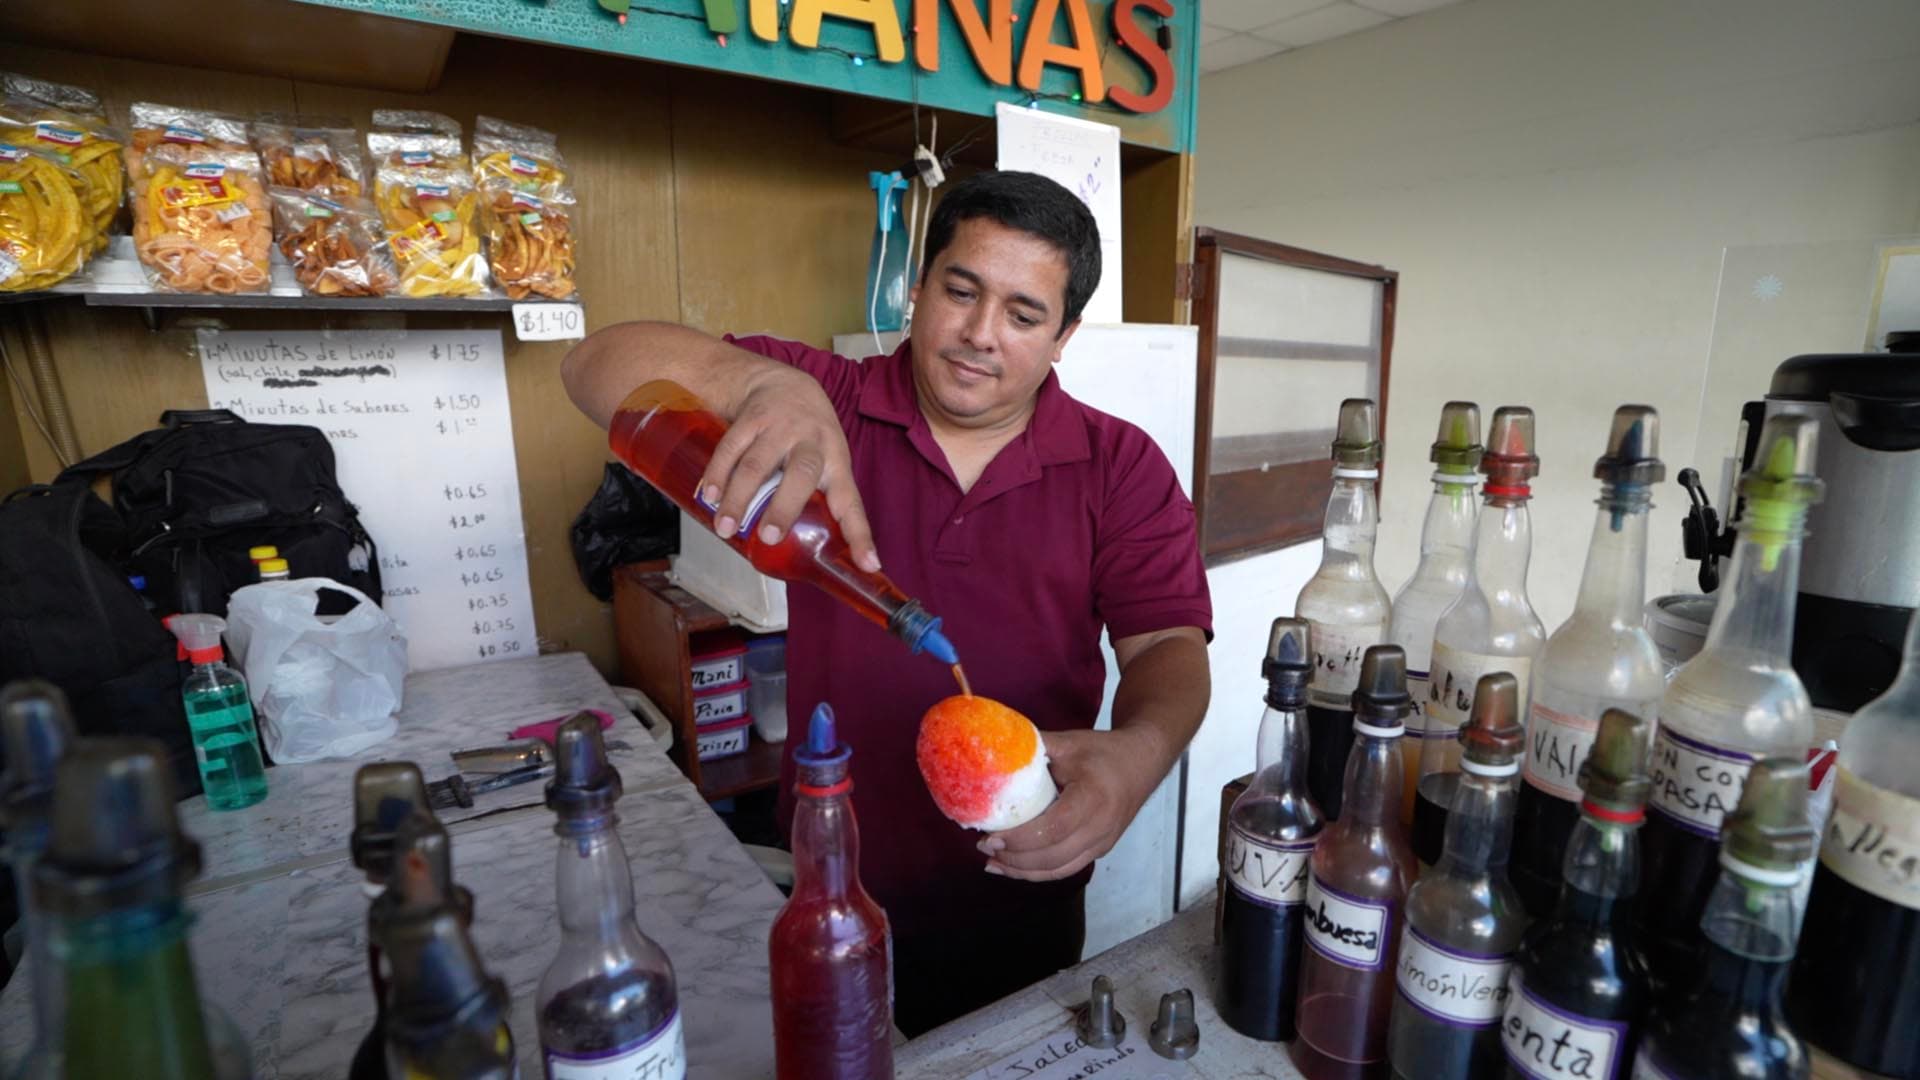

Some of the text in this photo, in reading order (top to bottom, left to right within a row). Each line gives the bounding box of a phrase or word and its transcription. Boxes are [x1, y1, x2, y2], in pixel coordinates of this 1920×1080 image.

[519, 310, 578, 333] $1.40
[455, 544, 497, 561] $0.65
[469, 593, 508, 611] $0.75
[1696, 765, 1746, 788] CO
[1501, 1014, 1597, 1080] enta
